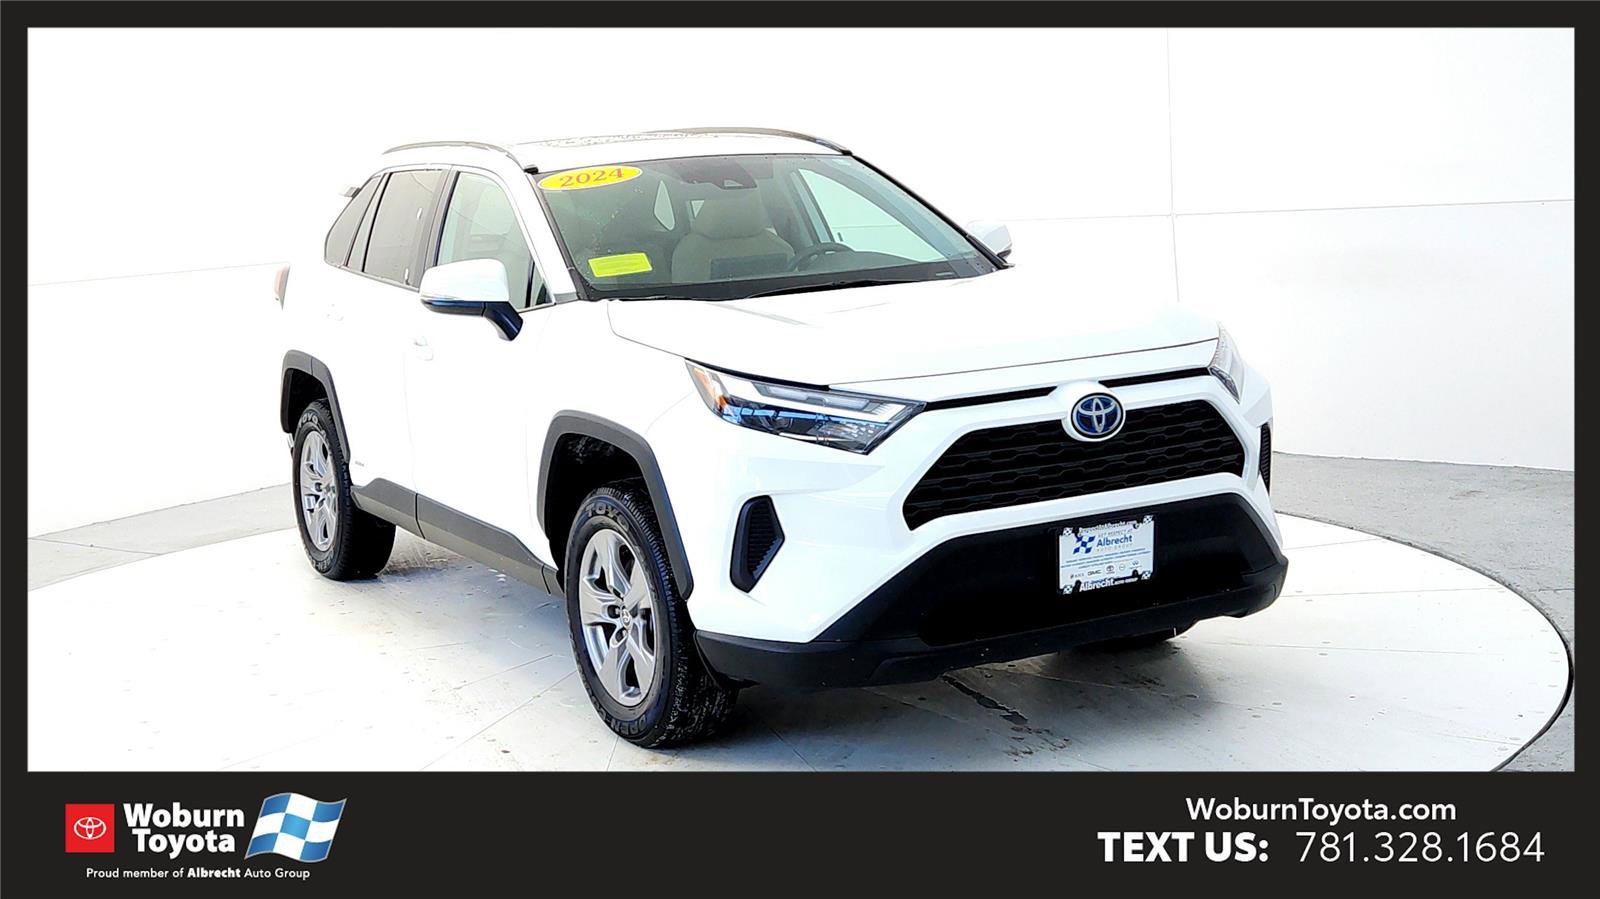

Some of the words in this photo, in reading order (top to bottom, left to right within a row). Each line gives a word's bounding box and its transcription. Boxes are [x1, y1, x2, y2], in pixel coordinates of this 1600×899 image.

[560, 167, 625, 188] 2024
[585, 501, 630, 532] TOYO
[1097, 534, 1133, 548] Albrecht
[1080, 578, 1115, 593] Albrecht
